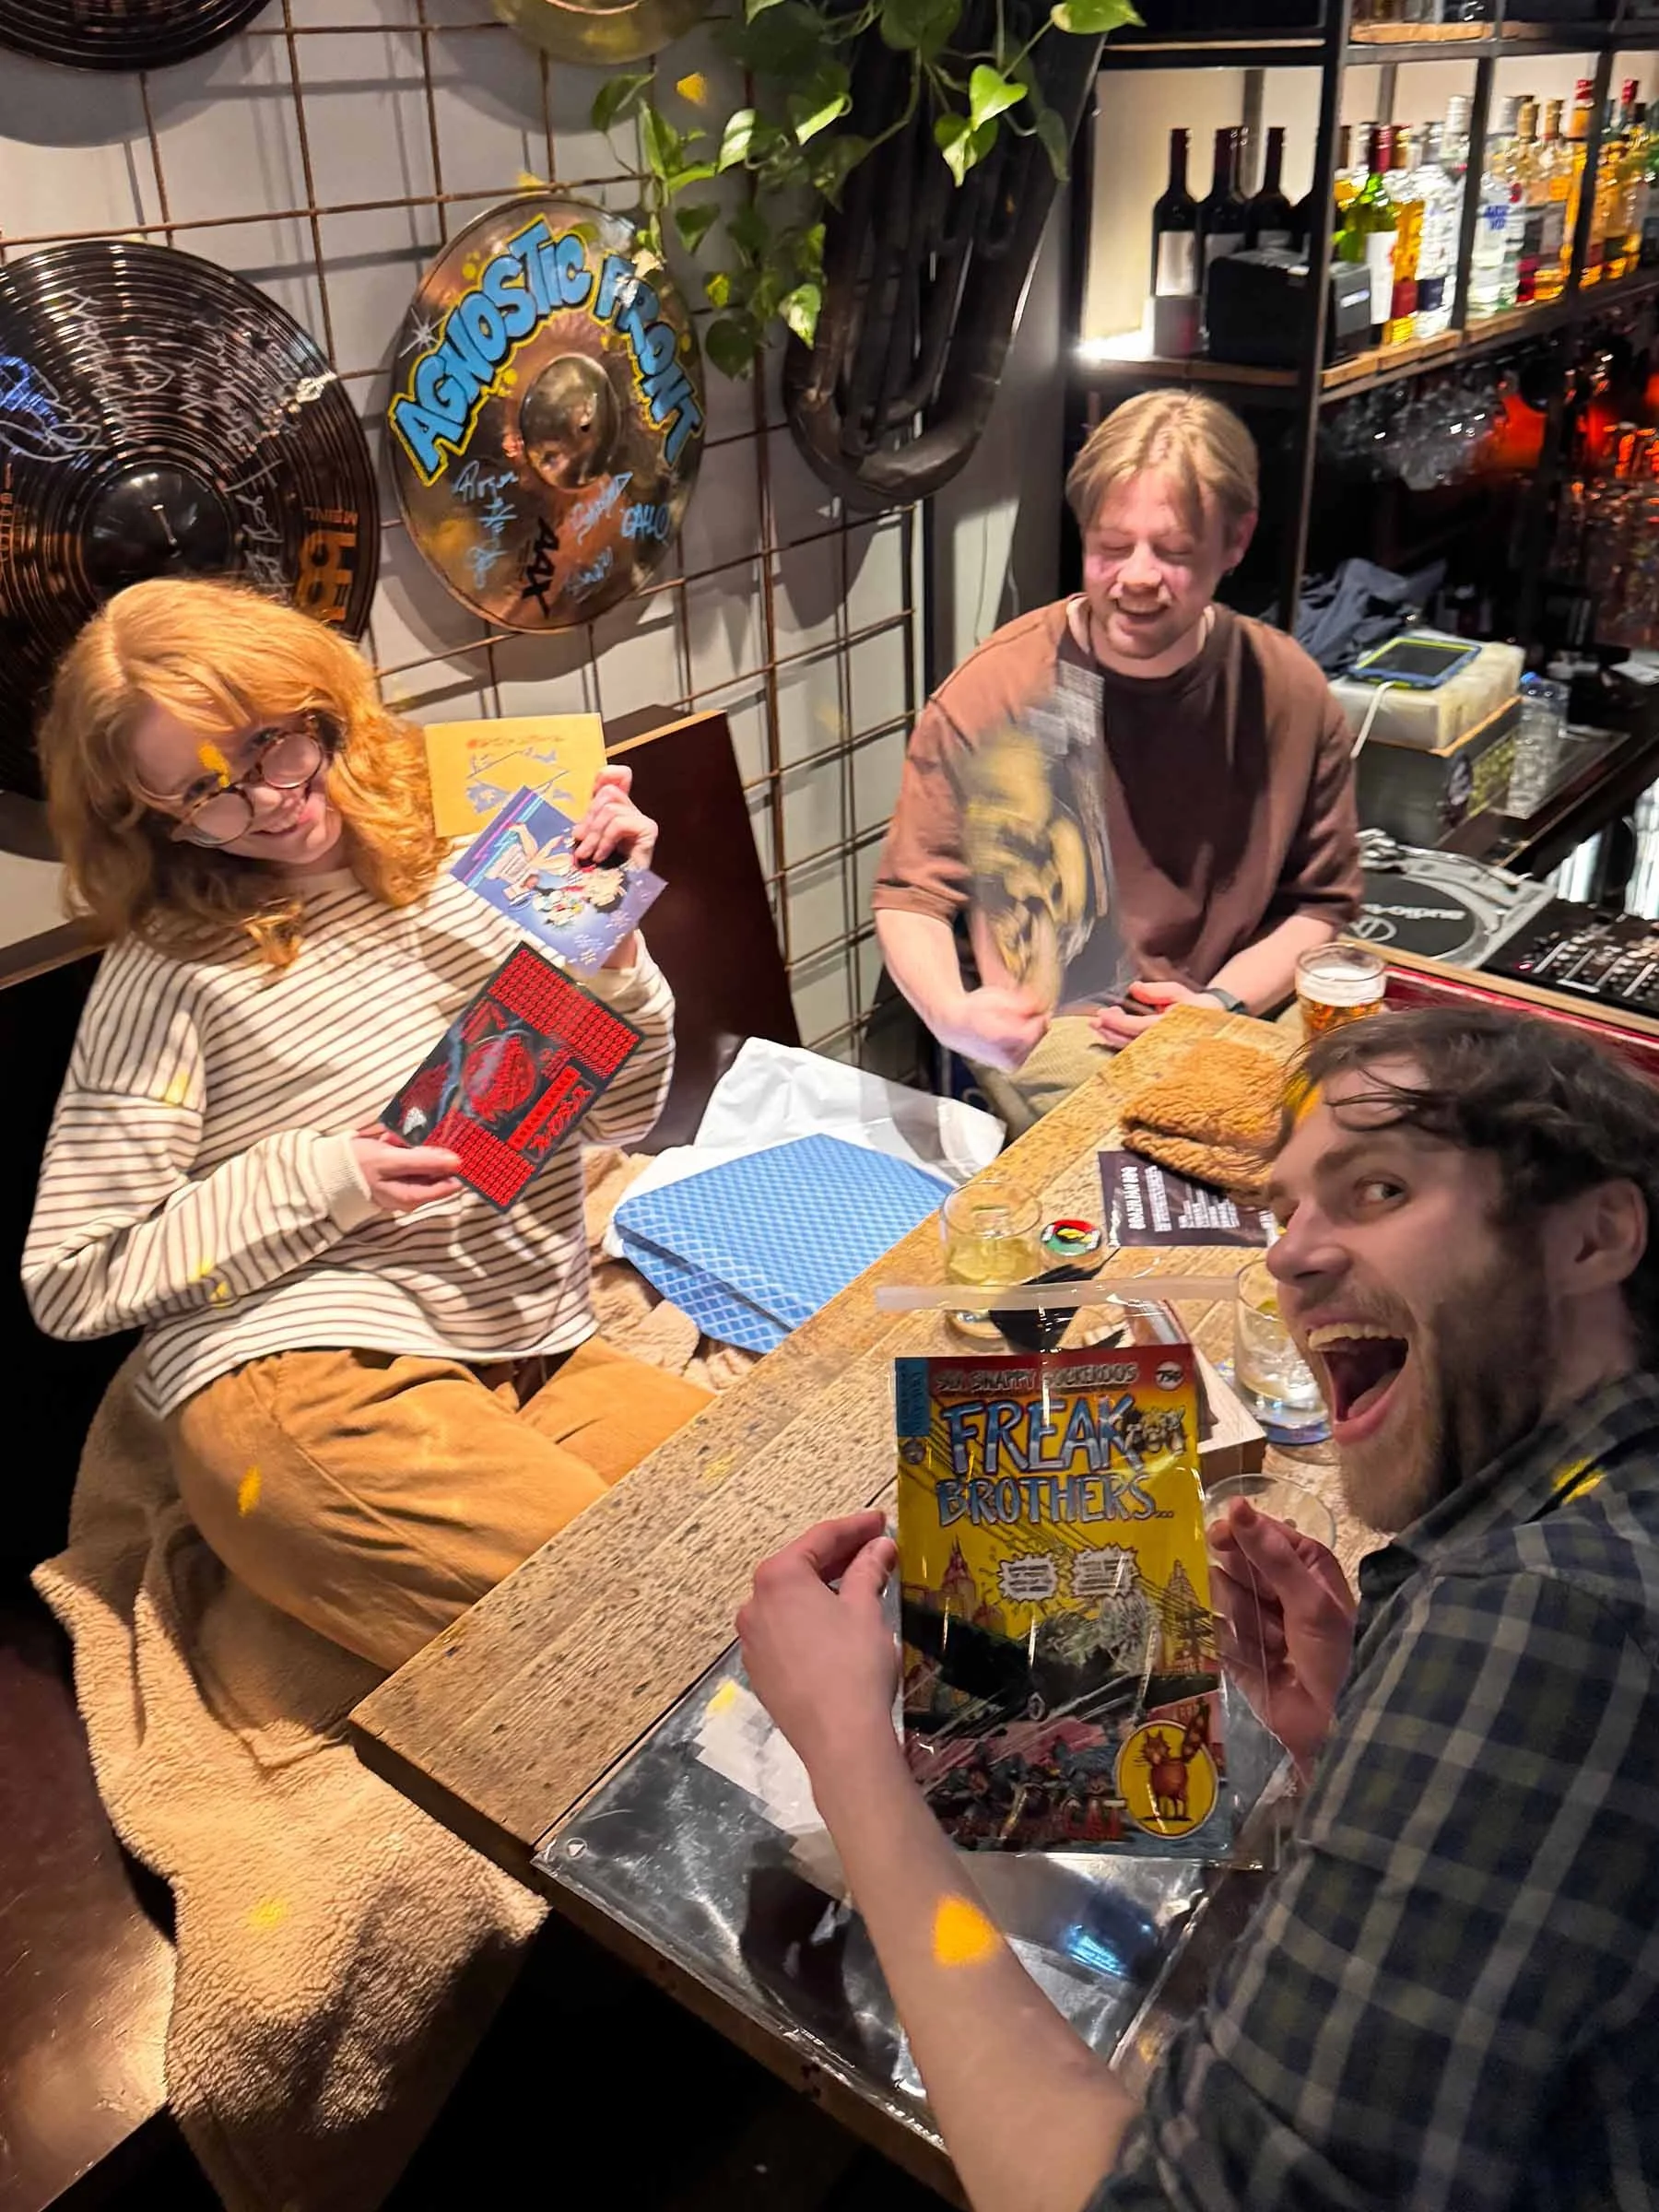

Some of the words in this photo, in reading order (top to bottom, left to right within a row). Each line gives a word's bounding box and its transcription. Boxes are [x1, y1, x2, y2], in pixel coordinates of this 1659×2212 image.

[391, 215, 594, 484] AGNOSTIC
[592, 251, 706, 465] FRONT
[970, 1368, 1036, 1394] SNAPPY
[940, 1392, 1145, 1475] FREAK
[1061, 1796, 1127, 1841] CAT
